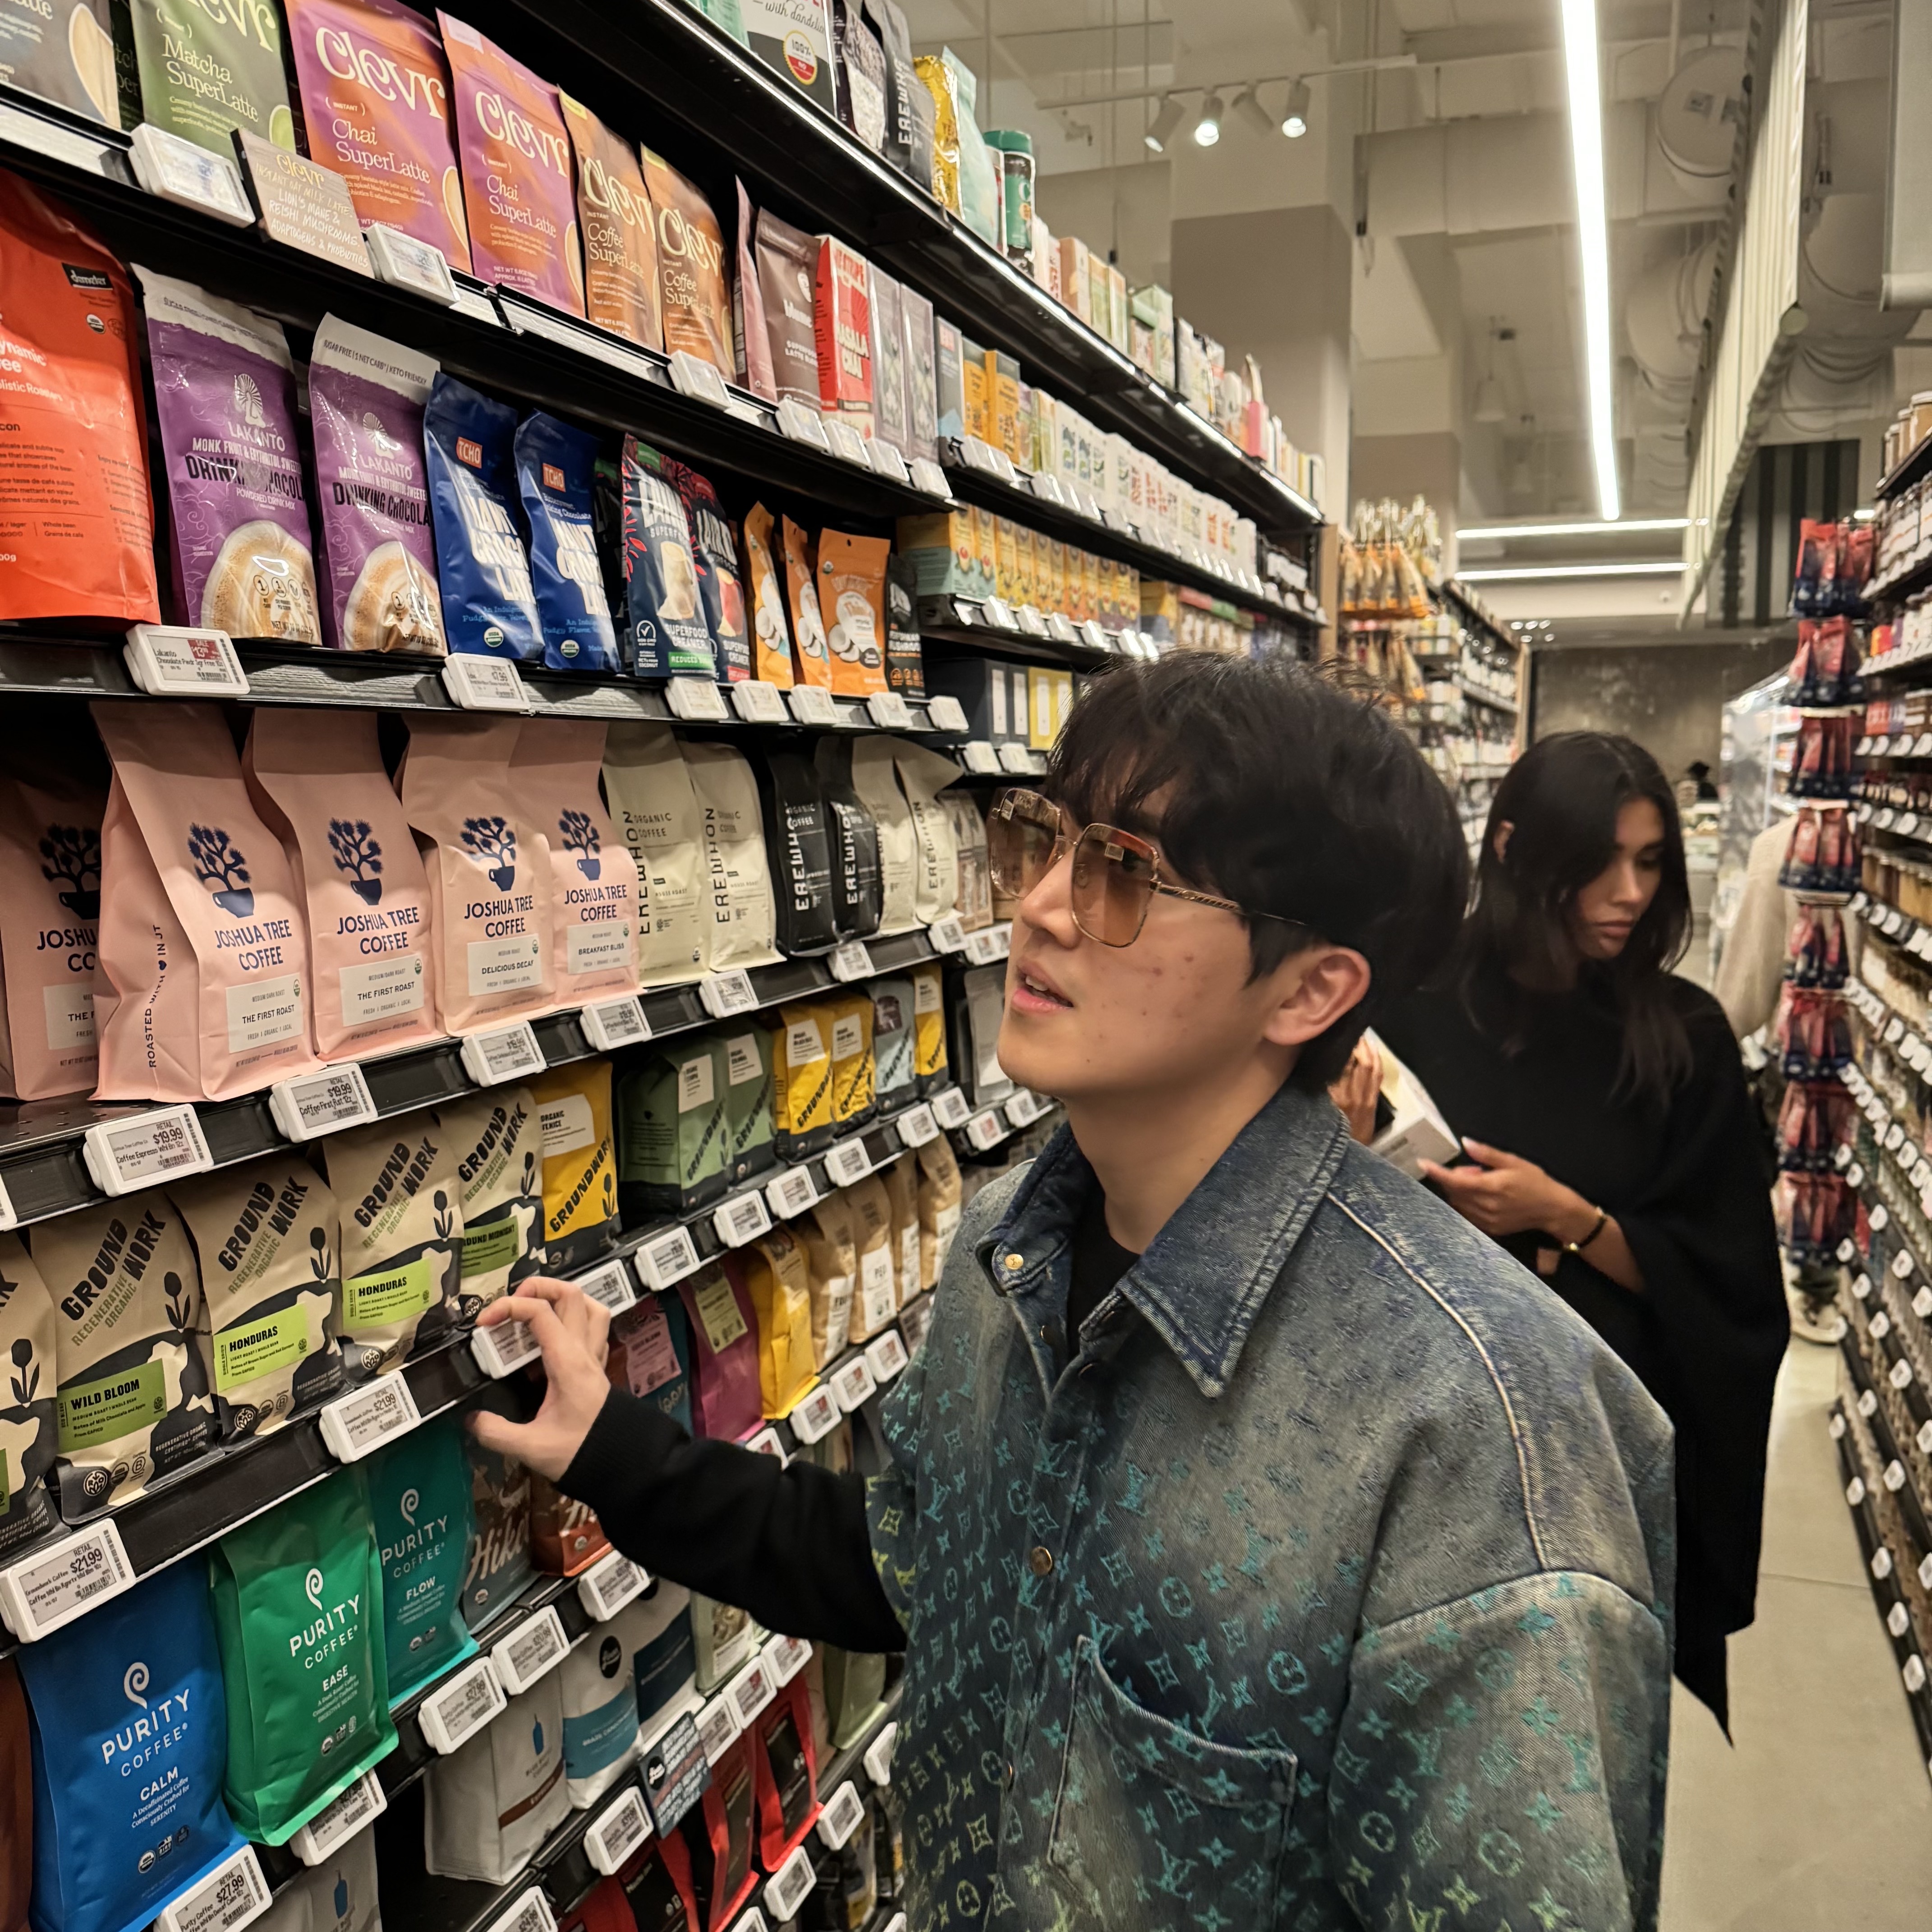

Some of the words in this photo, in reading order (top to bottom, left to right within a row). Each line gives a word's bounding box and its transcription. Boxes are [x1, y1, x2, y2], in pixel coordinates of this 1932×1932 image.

[765, 1, 788, 17] with
[162, 34, 232, 84] Matcha
[316, 27, 445, 120] Clevr
[166, 61, 259, 122] SuperLatte
[333, 119, 378, 145] Chai
[475, 91, 569, 178] Clevr
[336, 141, 431, 184] SuperLatte
[256, 162, 286, 186] INSTANT
[290, 180, 301, 192] OAT
[304, 187, 325, 202] MILK
[487, 175, 519, 201] Chai
[269, 199, 299, 221] REISHI
[279, 189, 305, 209] LION'S
[308, 202, 330, 221] MANE
[489, 195, 557, 238] SuperLatte
[271, 218, 316, 246] ADAPTOGENS
[588, 223, 624, 248] Coffee
[589, 243, 644, 279] SuperLatte
[664, 270, 697, 292] Coffee
[323, 340, 339, 352] SUGAR
[339, 345, 352, 357] FREE
[359, 354, 369, 364] NET
[389, 365, 405, 378] KETO
[405, 370, 427, 386] FRIENDLY
[193, 437, 221, 453] MONK
[227, 421, 285, 452] LAKANTO
[458, 441, 481, 465] TCHO
[360, 458, 413, 481] LAKANTO
[545, 466, 564, 489] TCHO
[332, 482, 386, 514] DRINKING
[665, 624, 708, 639] SUPERFOOD
[154, 648, 177, 658] Lakanto
[622, 810, 650, 934] EREWHON
[705, 808, 730, 923] EREWHON
[465, 899, 514, 919] JOSHUA
[514, 895, 534, 913] TREE
[565, 887, 605, 905] JOSHUA
[606, 884, 628, 899] TREE
[337, 913, 388, 935] JOSHUA
[387, 906, 420, 927] TREE
[581, 904, 617, 922] COFFEE
[152, 924, 161, 939] JT
[215, 923, 265, 949] JOSHUA
[263, 919, 292, 940] TREE
[485, 917, 526, 938] COFFEE
[157, 943, 166, 956] IN
[360, 931, 409, 955] COFFEE
[579, 944, 609, 956] BREAKFAST
[239, 946, 284, 971] COFFEE
[482, 963, 515, 975] DELICIOUS
[516, 959, 534, 969] DECAF
[149, 975, 166, 1004] WITH
[357, 991, 373, 1001] THE
[373, 986, 394, 998] FIRST
[395, 981, 415, 993] ROAST
[68, 1012, 90, 1022] THE
[242, 1014, 256, 1024] THE
[257, 1009, 275, 1021] FIRST
[276, 1004, 295, 1016] ROAST
[363, 1007, 375, 1015] FRESH
[144, 1008, 157, 1068] ROASTED
[248, 1032, 259, 1040] FRESH
[264, 1027, 278, 1036] ORGANIC
[319, 1099, 334, 1110] First
[333, 1098, 343, 1108] Rst
[327, 1083, 353, 1098] $19.99
[153, 1127, 184, 1145] $19.99
[156, 1122, 174, 1130] RETAIL
[501, 1102, 528, 1156] WORK
[116, 1154, 136, 1164] Coffee
[135, 1148, 158, 1160] Espresso
[458, 1106, 507, 1182] GROUND
[401, 1136, 438, 1197] WORK
[464, 1149, 504, 1202] REGENERATIVE
[354, 1142, 410, 1228] GROUND
[267, 1175, 309, 1237] WORK
[362, 1190, 405, 1249] REGENERATIVE
[387, 1198, 411, 1235] ORGANIC
[218, 1182, 276, 1272] GROUND
[488, 1224, 515, 1243] MIDNIGHT
[122, 1209, 166, 1282] WORK
[255, 1238, 281, 1279] ORGANIC
[60, 1218, 129, 1320] GROUND
[228, 1230, 271, 1294] REGENERATIVE
[359, 1276, 407, 1297] HONDURAS
[71, 1273, 130, 1346] REGENERATIVE
[106, 1283, 138, 1328] ORGANIC
[229, 1325, 278, 1352] HONDURAS
[70, 1389, 102, 1411] WILD
[104, 1378, 140, 1402] BLOOM
[72, 1412, 93, 1421] MEDIUM
[93, 1407, 109, 1417] ROAST
[73, 1543, 93, 1557] RETAIL
[381, 1514, 449, 1567] PURITY
[393, 1544, 442, 1578] COFFEE
[52, 1570, 69, 1582] Coffee
[406, 1576, 436, 1601] FLOW
[29, 1594, 47, 1606] Coffee
[289, 1593, 360, 1658] PURITY
[304, 1628, 354, 1670] COFFEE
[322, 1664, 349, 1692] EASE
[101, 1688, 191, 1765] PURITY
[121, 1723, 183, 1778] COFFEE
[138, 1786, 174, 1816] Decaffeinated
[173, 1776, 189, 1791] Coffee
[140, 1766, 178, 1801] CALM
[131, 1803, 164, 1829] Consciously
[163, 1789, 183, 1807] Crafted
[182, 1784, 190, 1794] for
[150, 1803, 177, 1827] SERENITY
[216, 1874, 245, 1903] $27.99
[219, 1872, 236, 1886] RETAIL
[180, 1917, 197, 1932] Purity
[195, 1904, 214, 1920] Coffee
